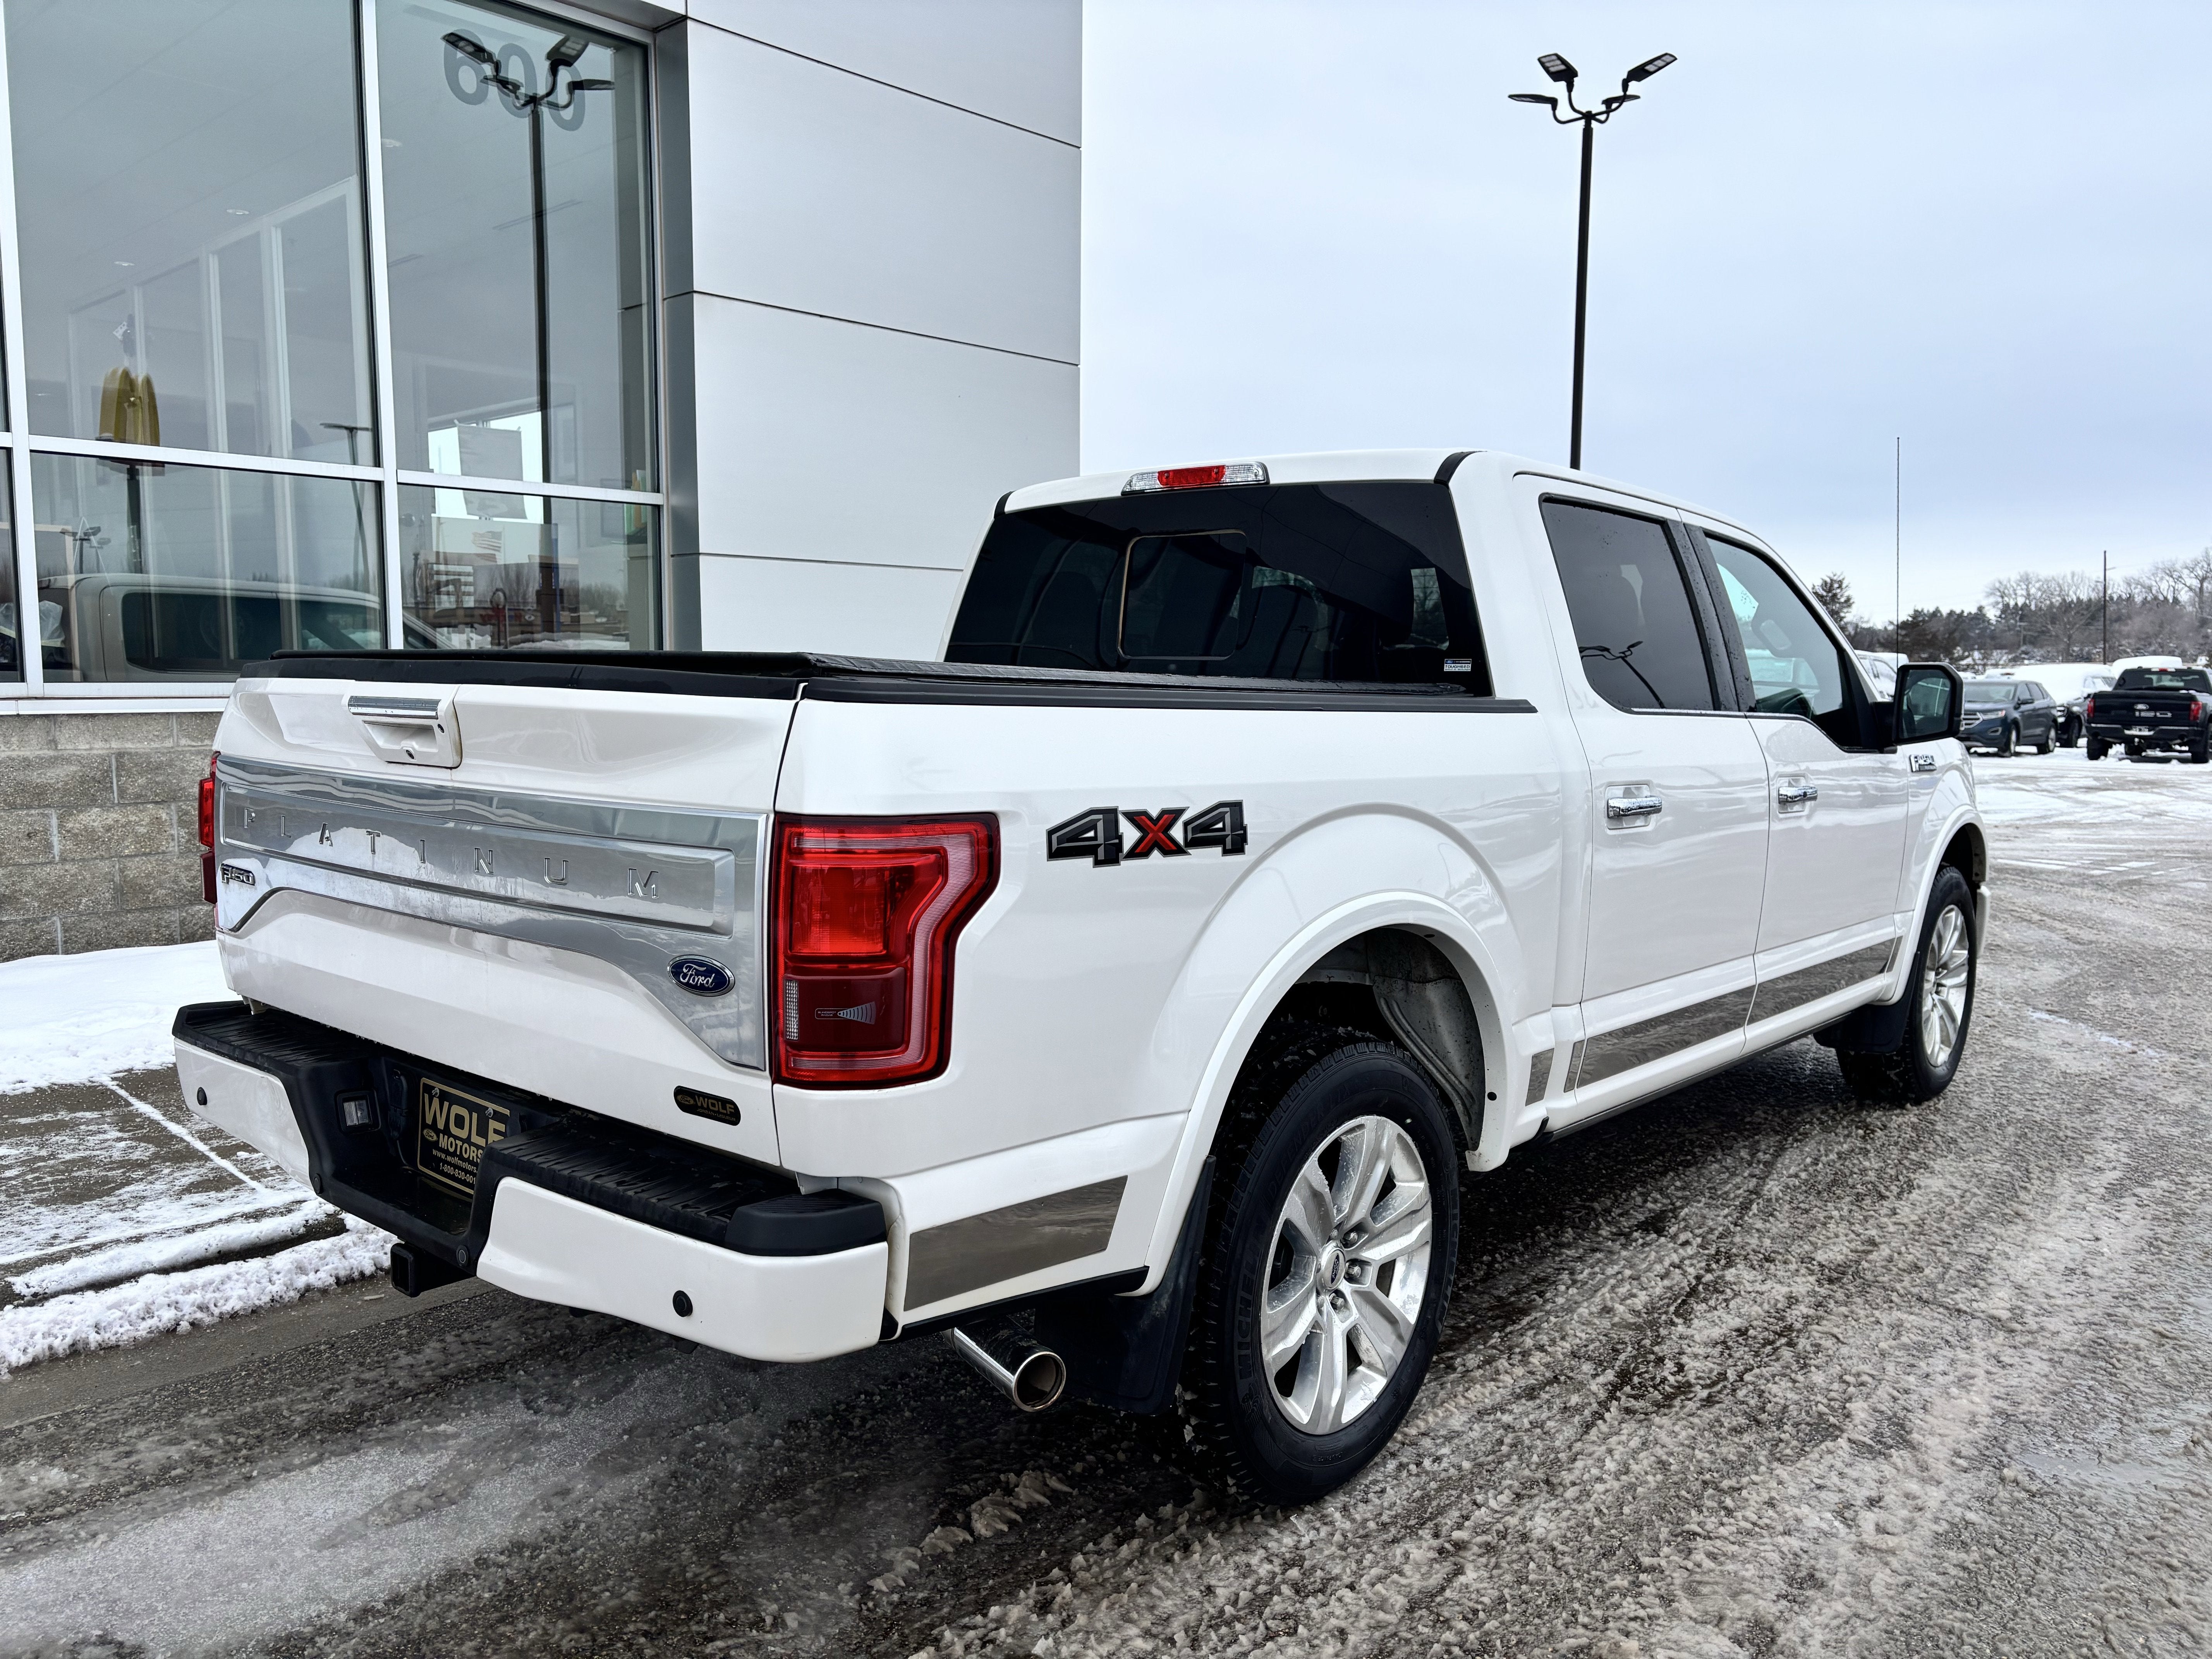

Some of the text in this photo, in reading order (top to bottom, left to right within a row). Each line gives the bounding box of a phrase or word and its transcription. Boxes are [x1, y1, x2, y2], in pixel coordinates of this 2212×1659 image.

[444, 29, 585, 131] 600
[244, 807, 659, 899] PLATINUM
[680, 963, 715, 988] Ford
[680, 1096, 692, 1104] Ford
[695, 1095, 735, 1114] WOLF
[424, 1093, 505, 1147] WOLF
[433, 1149, 478, 1173] www.wolfmotors.
[439, 1133, 483, 1163] MOTORS
[440, 1163, 476, 1184] 1-800-830-001
[1237, 1215, 1267, 1380] MICHELIN
